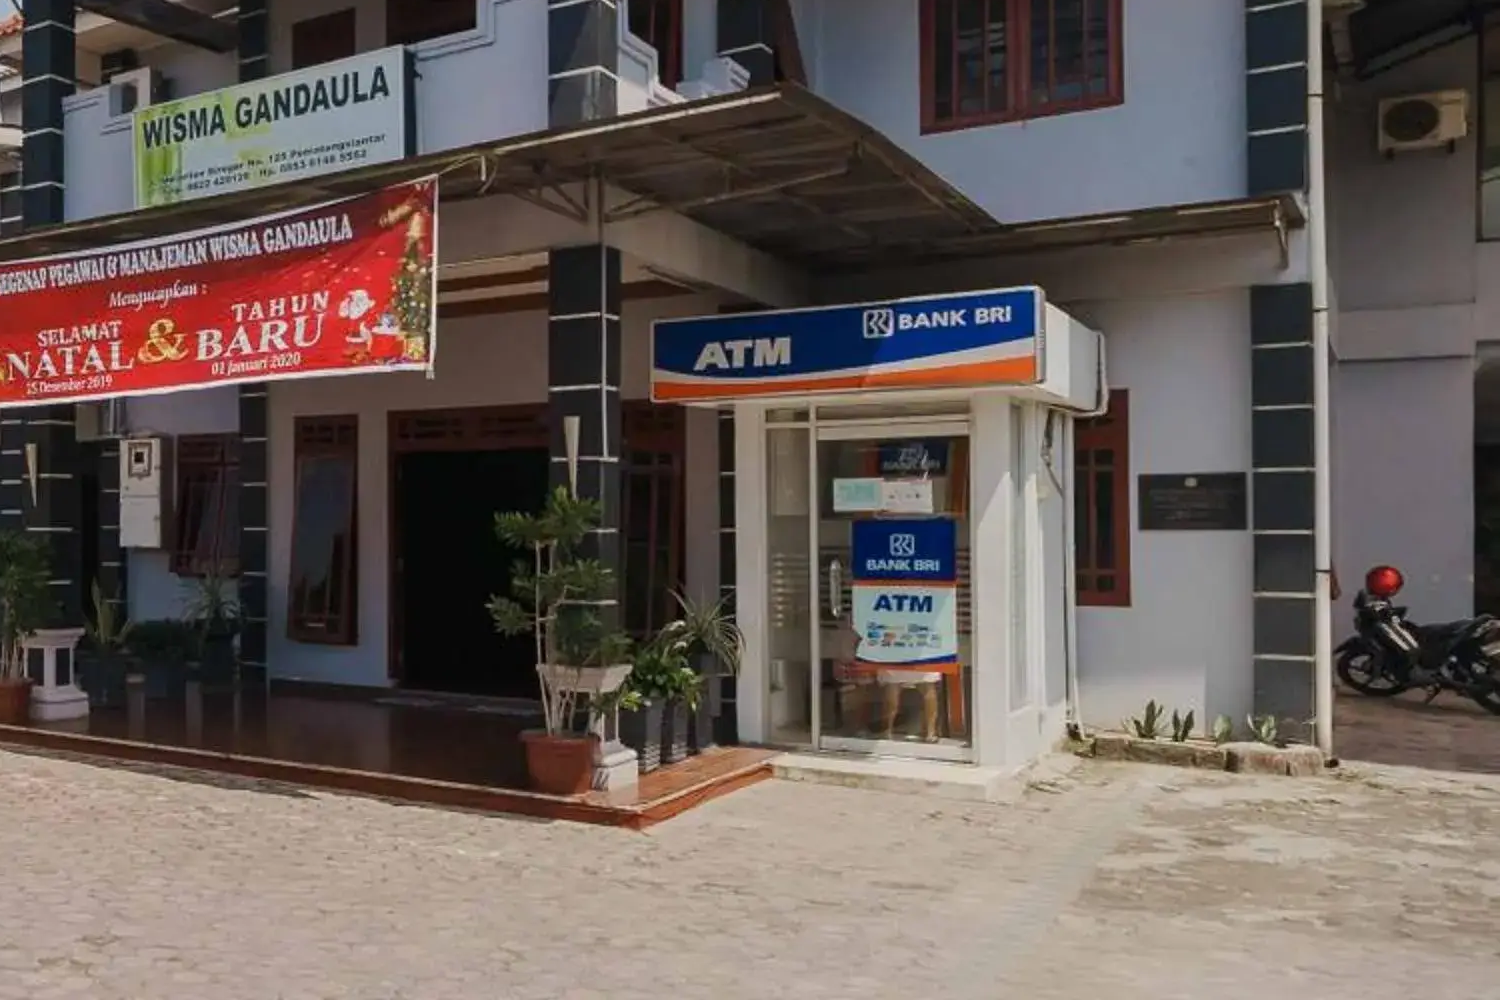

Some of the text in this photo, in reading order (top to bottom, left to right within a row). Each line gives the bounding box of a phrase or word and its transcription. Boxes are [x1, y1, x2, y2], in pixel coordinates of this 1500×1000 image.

[142, 65, 390, 150] WISMA GANDAULA
[49, 255, 106, 288] PEGAWAI
[118, 238, 208, 277] MANAJEMAN
[208, 229, 263, 262] WISMA
[262, 212, 353, 253] GANDAULA
[109, 279, 198, 312] Mengucapkan
[231, 290, 330, 323] TAHUN
[898, 310, 967, 330] BANK
[975, 305, 1012, 324] BRI
[5, 312, 326, 381] NATAL & BARU
[37, 319, 123, 348] SELAMAT
[269, 351, 302, 369] 2020
[693, 336, 792, 371] ATM
[86, 373, 113, 389] 2019
[866, 559, 940, 572] BANK BRI
[873, 594, 933, 613] ATM
